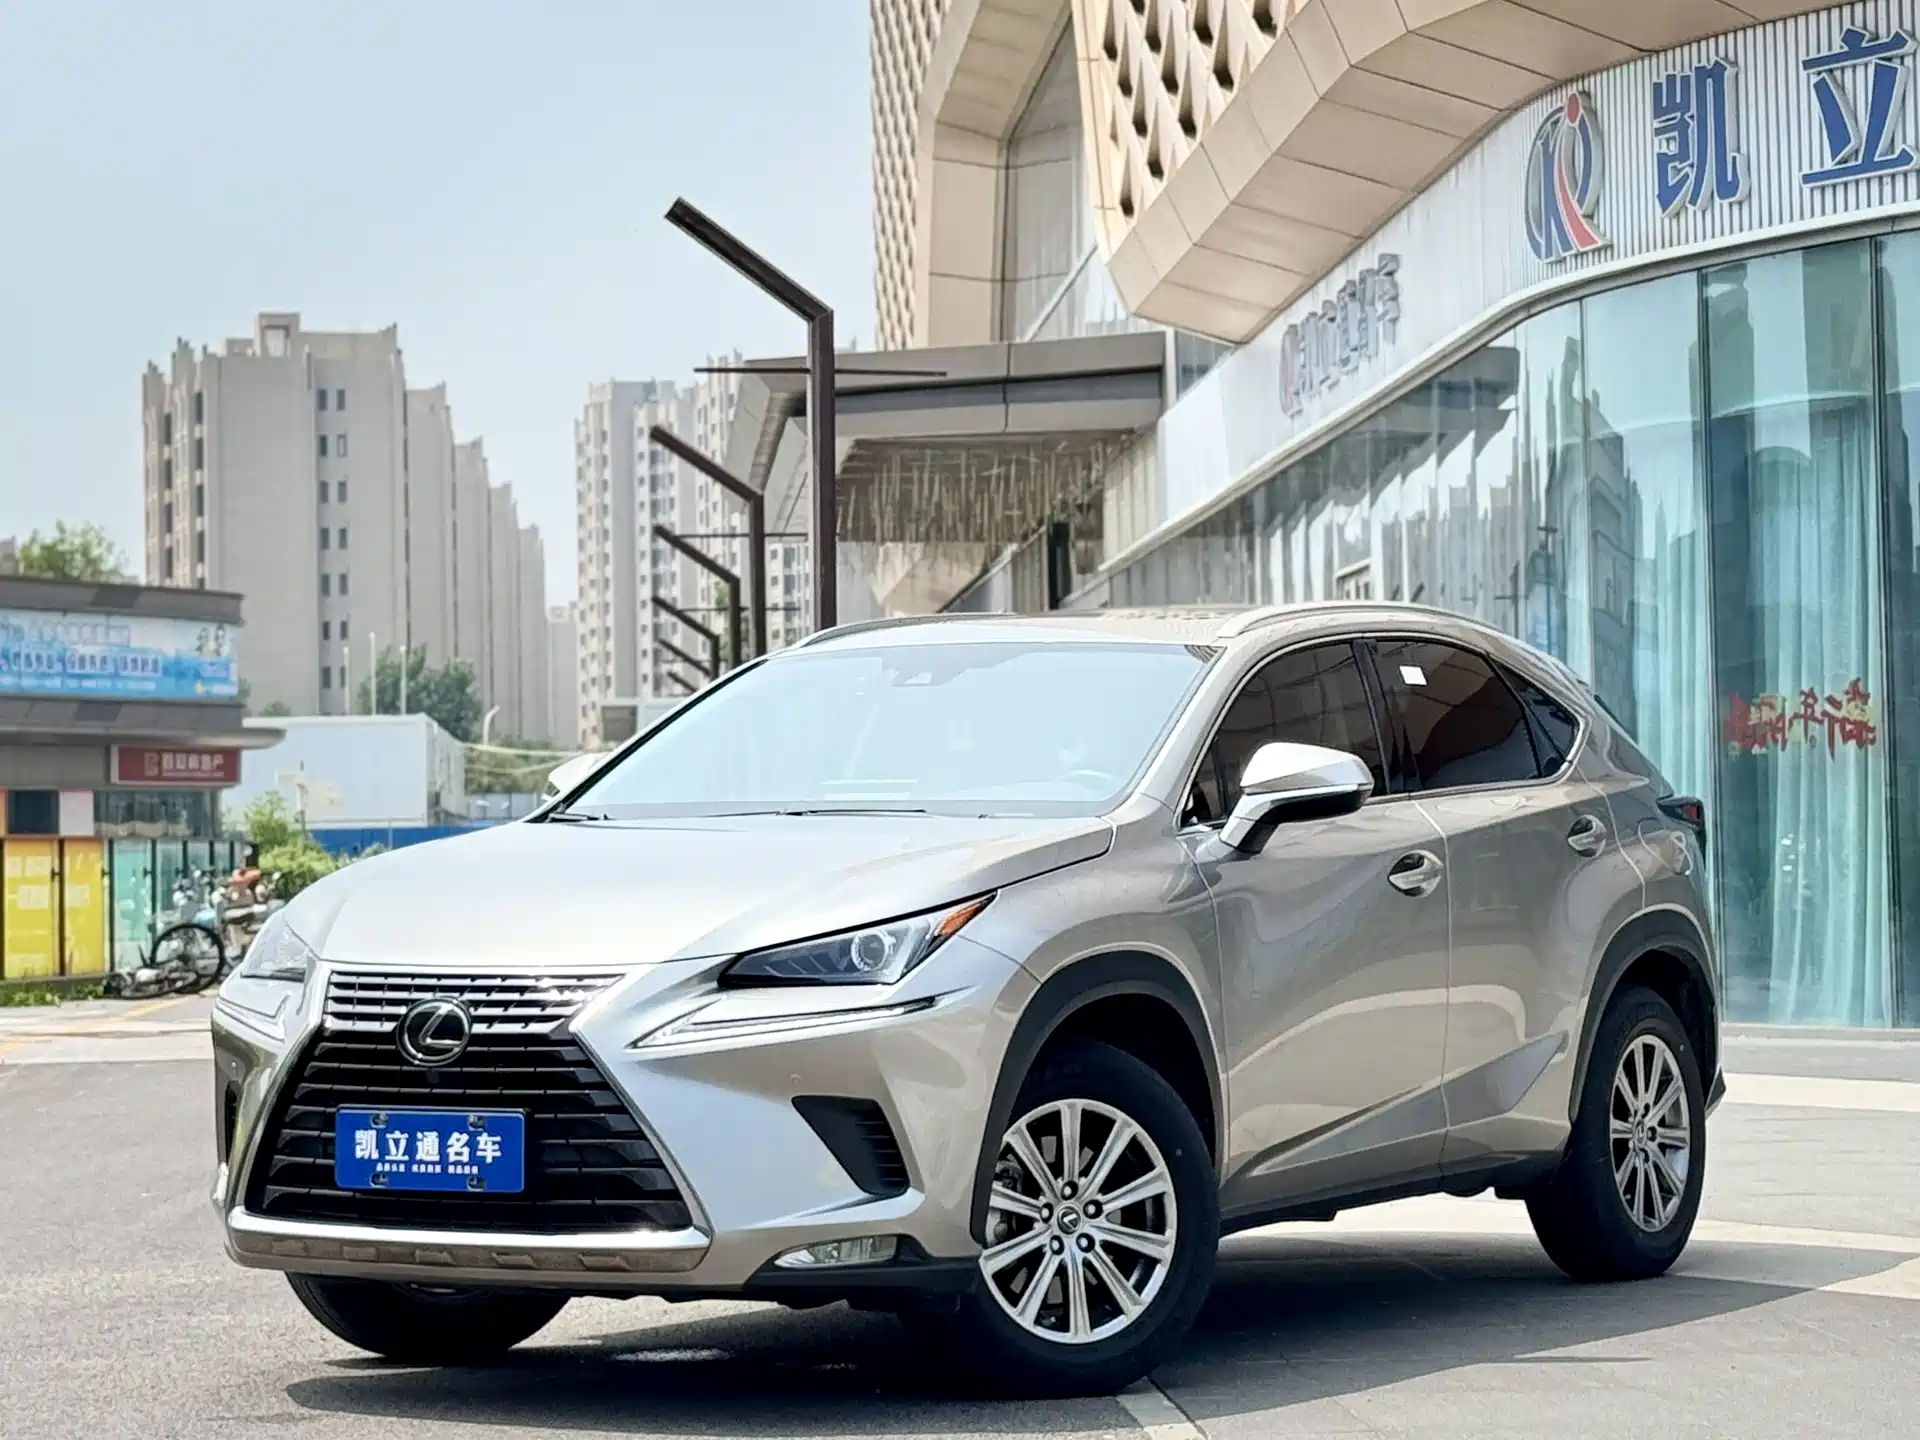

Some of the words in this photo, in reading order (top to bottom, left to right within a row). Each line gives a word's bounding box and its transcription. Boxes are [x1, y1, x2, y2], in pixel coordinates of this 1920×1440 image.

[1652, 26, 1916, 217] 凯立
[354, 1129, 502, 1163] 凯立通名车
